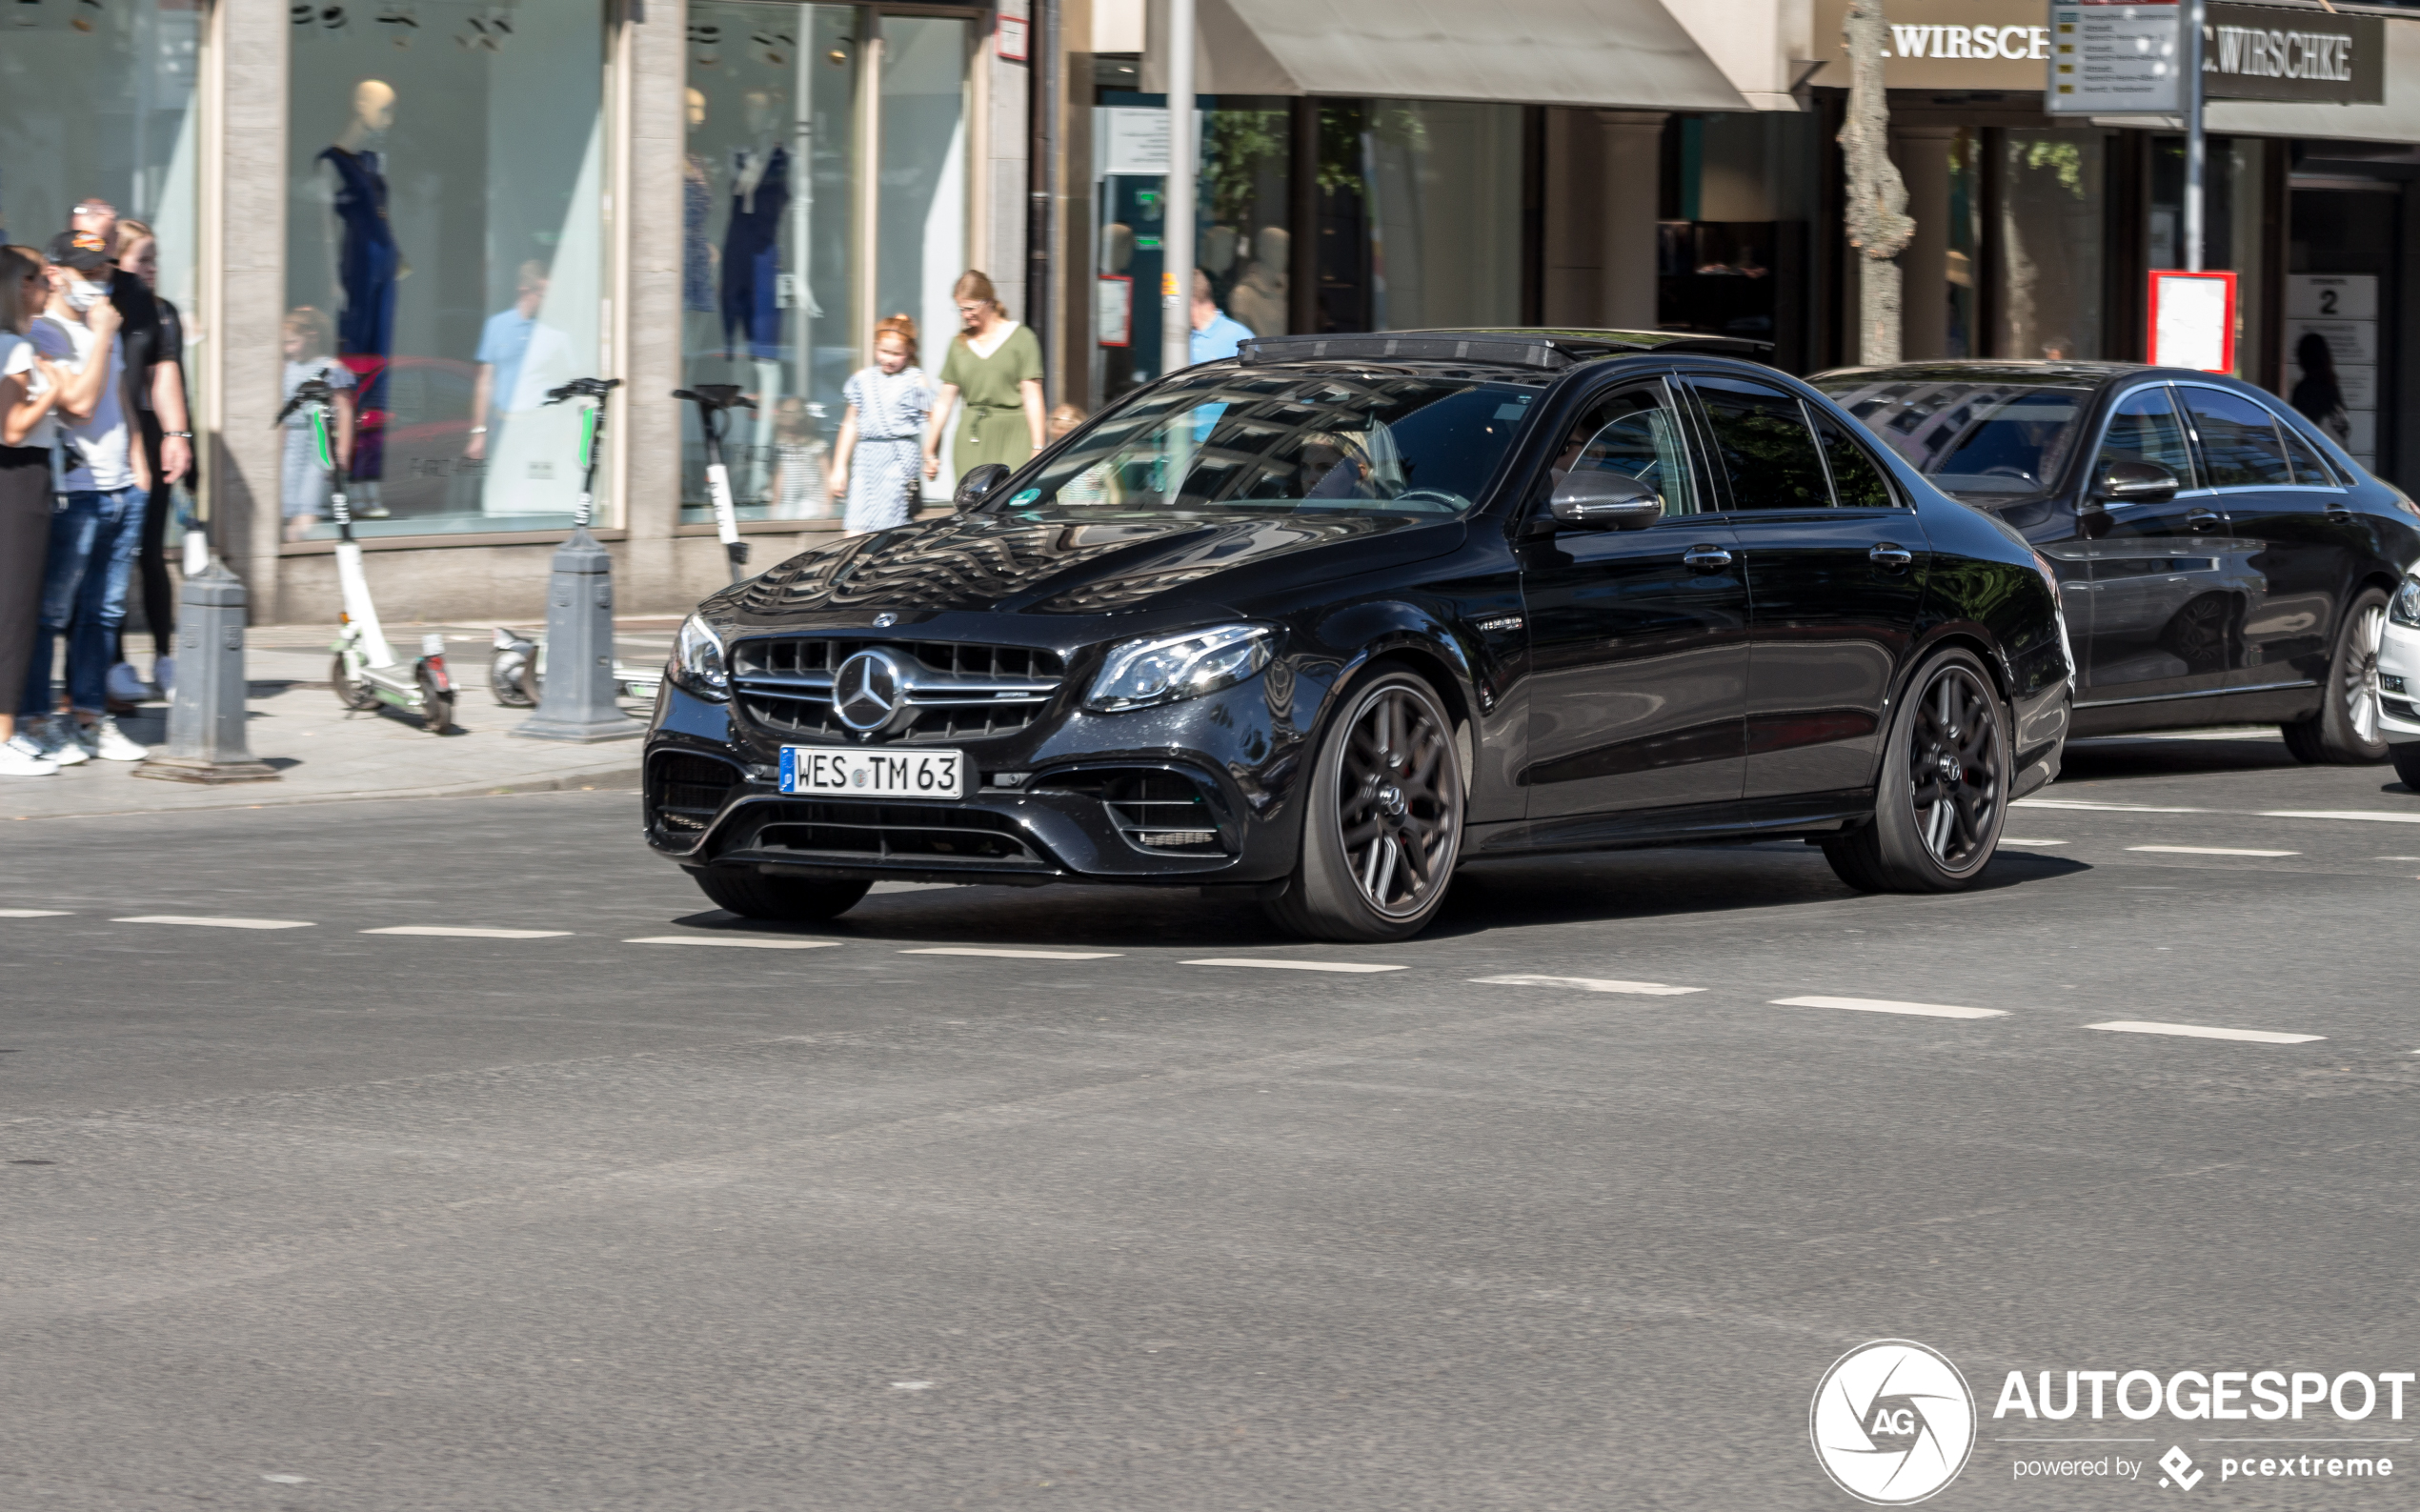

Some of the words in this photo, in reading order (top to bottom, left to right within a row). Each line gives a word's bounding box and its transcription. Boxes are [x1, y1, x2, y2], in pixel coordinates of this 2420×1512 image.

[2319, 290, 2338, 314] 2
[797, 755, 847, 788] WES
[869, 756, 908, 790] TM
[918, 757, 955, 790] 63
